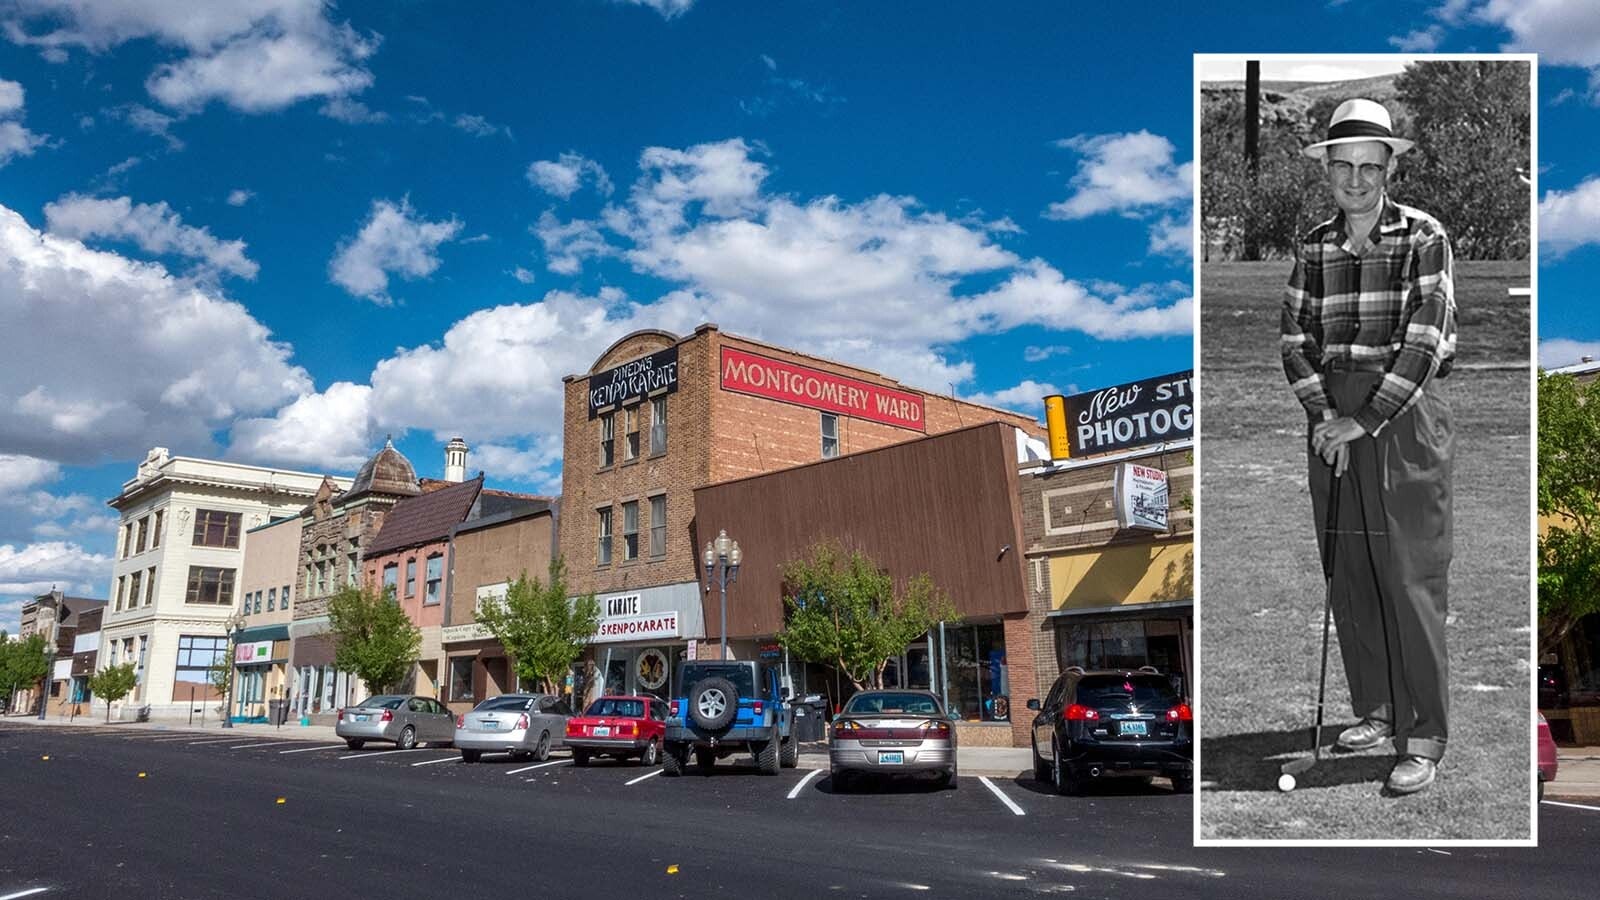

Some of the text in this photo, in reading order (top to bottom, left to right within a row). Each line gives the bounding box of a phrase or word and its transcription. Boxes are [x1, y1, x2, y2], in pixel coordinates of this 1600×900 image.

[589, 361, 677, 410] KENPO KARATE
[612, 356, 653, 384] PINEDA'S
[724, 357, 921, 423] MONTGOMERY WARD
[1079, 384, 1143, 424] New
[1077, 404, 1193, 450] PHOTOG
[1133, 465, 1146, 478] NEW
[1146, 468, 1165, 482] STUDIO
[607, 596, 638, 617] KARATE
